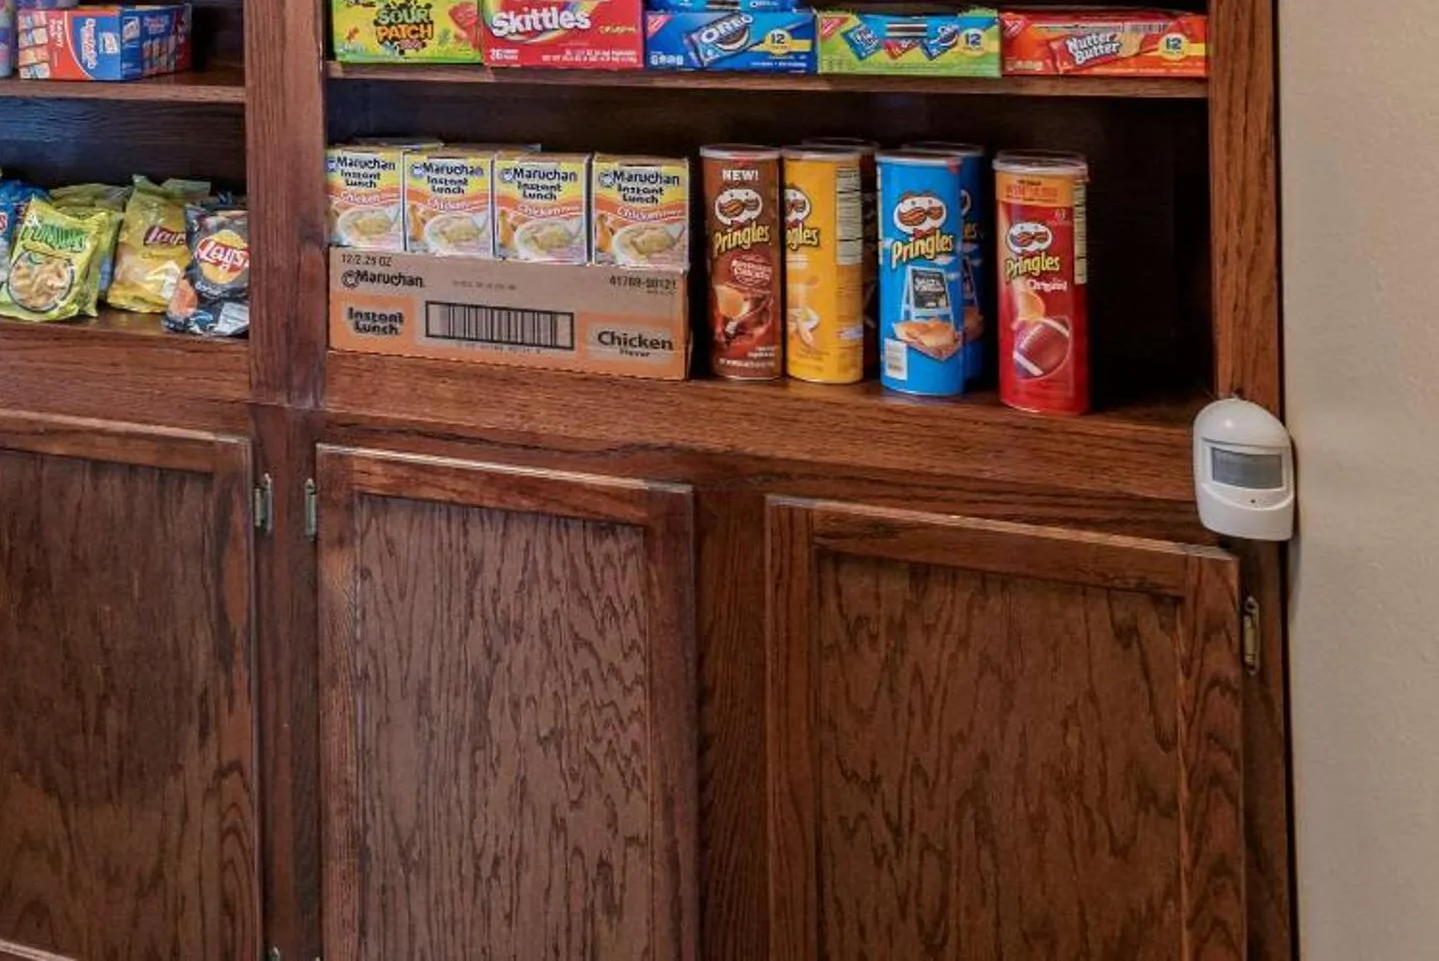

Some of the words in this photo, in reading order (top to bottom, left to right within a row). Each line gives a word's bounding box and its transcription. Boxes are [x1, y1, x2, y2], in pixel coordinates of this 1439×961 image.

[377, 8, 429, 24] SOUR
[490, 6, 592, 37] Skittles
[376, 24, 434, 41] PATCH
[771, 33, 785, 45] 12
[966, 33, 981, 46] 12
[1066, 32, 1112, 54] Nutter
[1165, 38, 1182, 50] 12
[336, 156, 396, 171] Maruchan
[423, 162, 484, 177] Maruchan
[513, 167, 578, 182] Maruchan
[612, 170, 680, 187] Maruchan
[722, 169, 759, 181] NEW!
[523, 191, 557, 201] Lunch
[622, 194, 659, 205] Lunch
[714, 223, 771, 258] Pringles
[199, 240, 248, 273] Lay's
[891, 231, 954, 269] Pringles
[378, 255, 393, 267] OZ
[1006, 254, 1060, 281] Pringles
[357, 270, 424, 288] Maruchan
[348, 307, 405, 324] Instant
[355, 321, 399, 335] Lunch
[597, 330, 674, 351] Chicken
